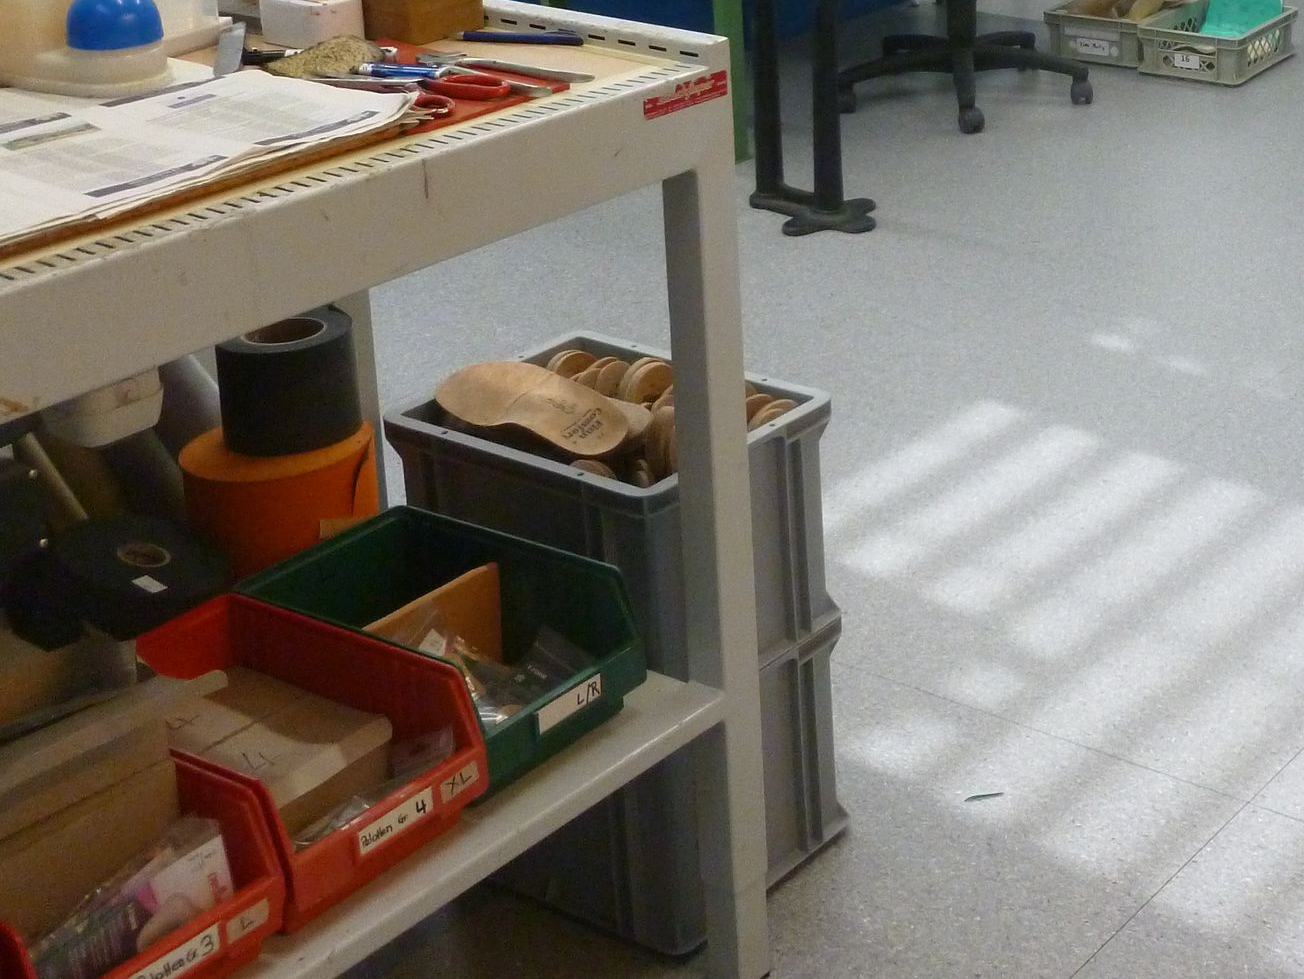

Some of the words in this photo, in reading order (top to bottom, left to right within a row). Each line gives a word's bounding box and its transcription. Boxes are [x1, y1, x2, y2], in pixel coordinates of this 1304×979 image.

[577, 682, 600, 705] L/R
[445, 772, 472, 796] XL
[416, 799, 427, 813] 4
[201, 934, 214, 955] 3
